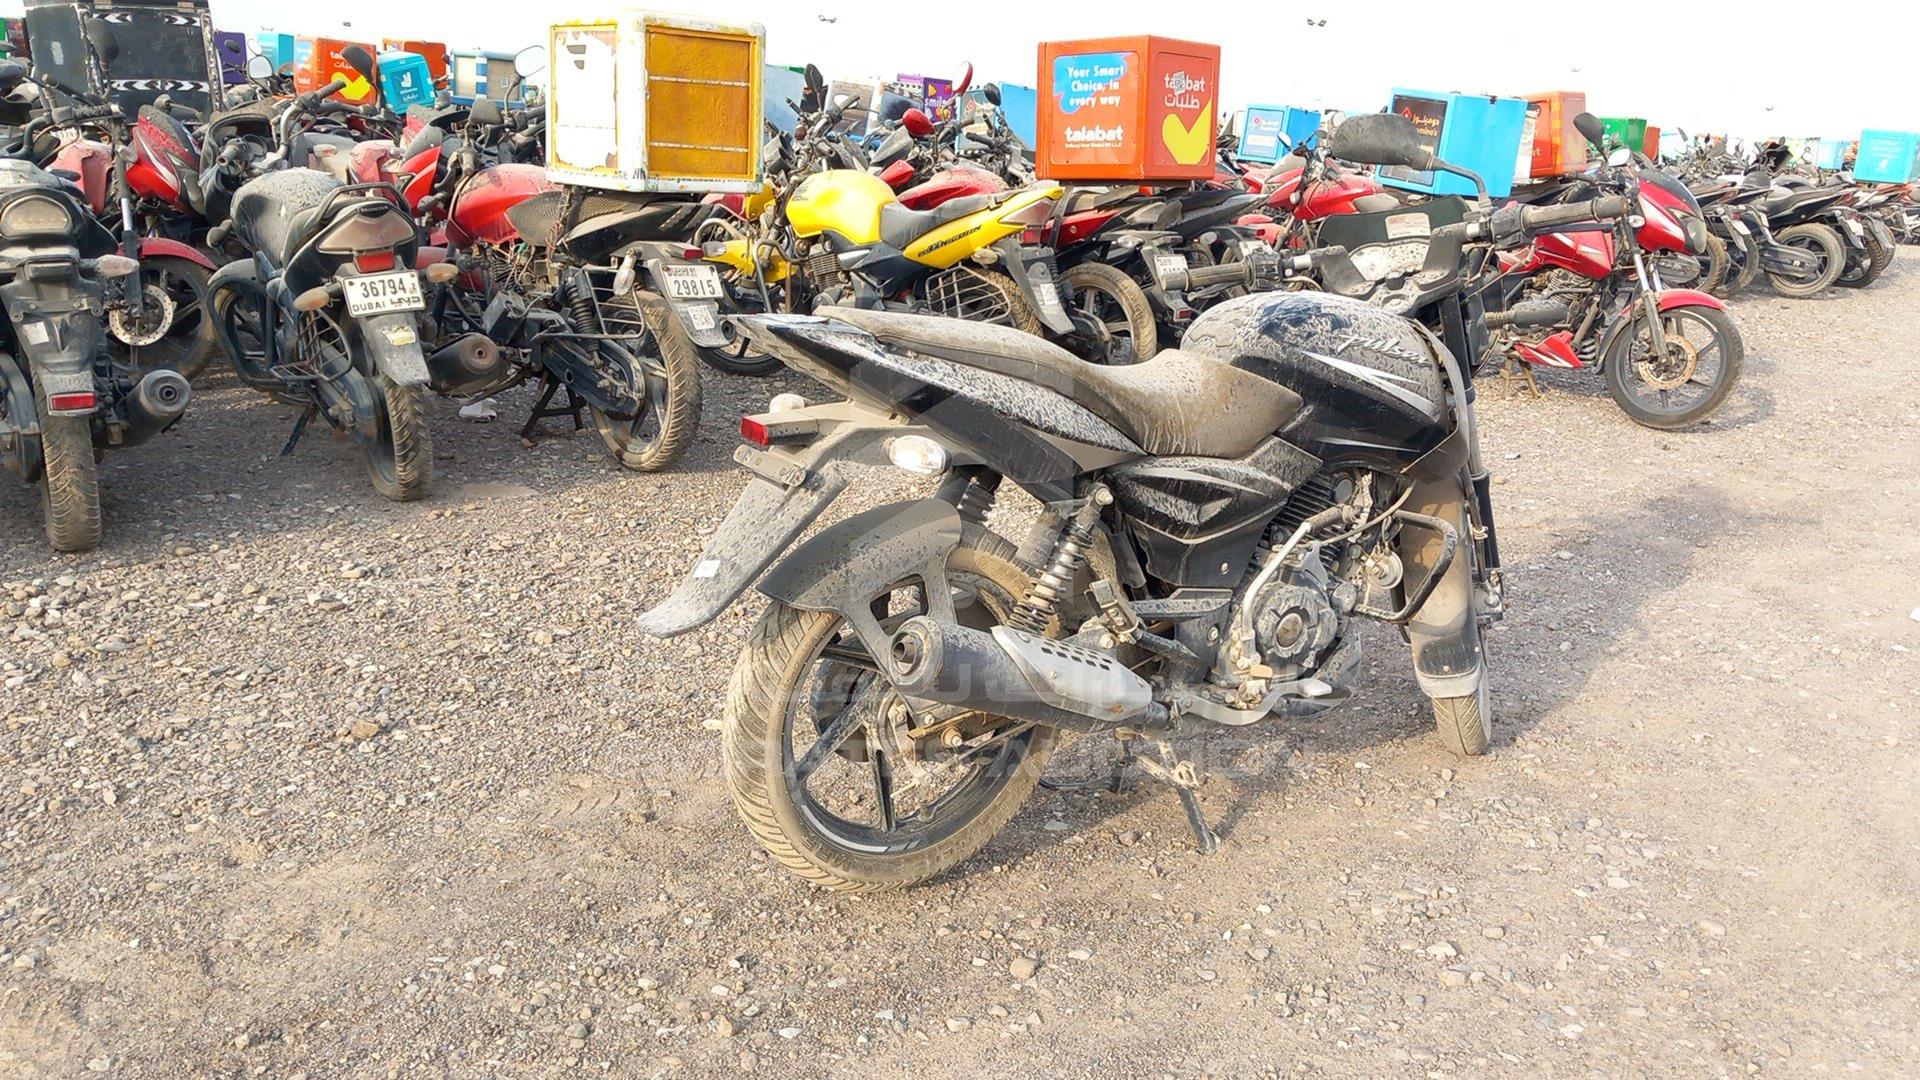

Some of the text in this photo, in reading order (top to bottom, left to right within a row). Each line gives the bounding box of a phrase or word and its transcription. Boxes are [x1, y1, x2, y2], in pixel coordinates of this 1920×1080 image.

[1067, 65, 1125, 78] Your Smart
[1071, 80, 1106, 93] Choice,
[1164, 72, 1206, 92] tabat
[1069, 95, 1121, 108] every way
[1164, 93, 1200, 111] طلبات
[1064, 125, 1124, 142] talabat
[360, 277, 406, 298] 36794
[674, 279, 716, 297] 29815
[352, 300, 386, 313] DUBAI
